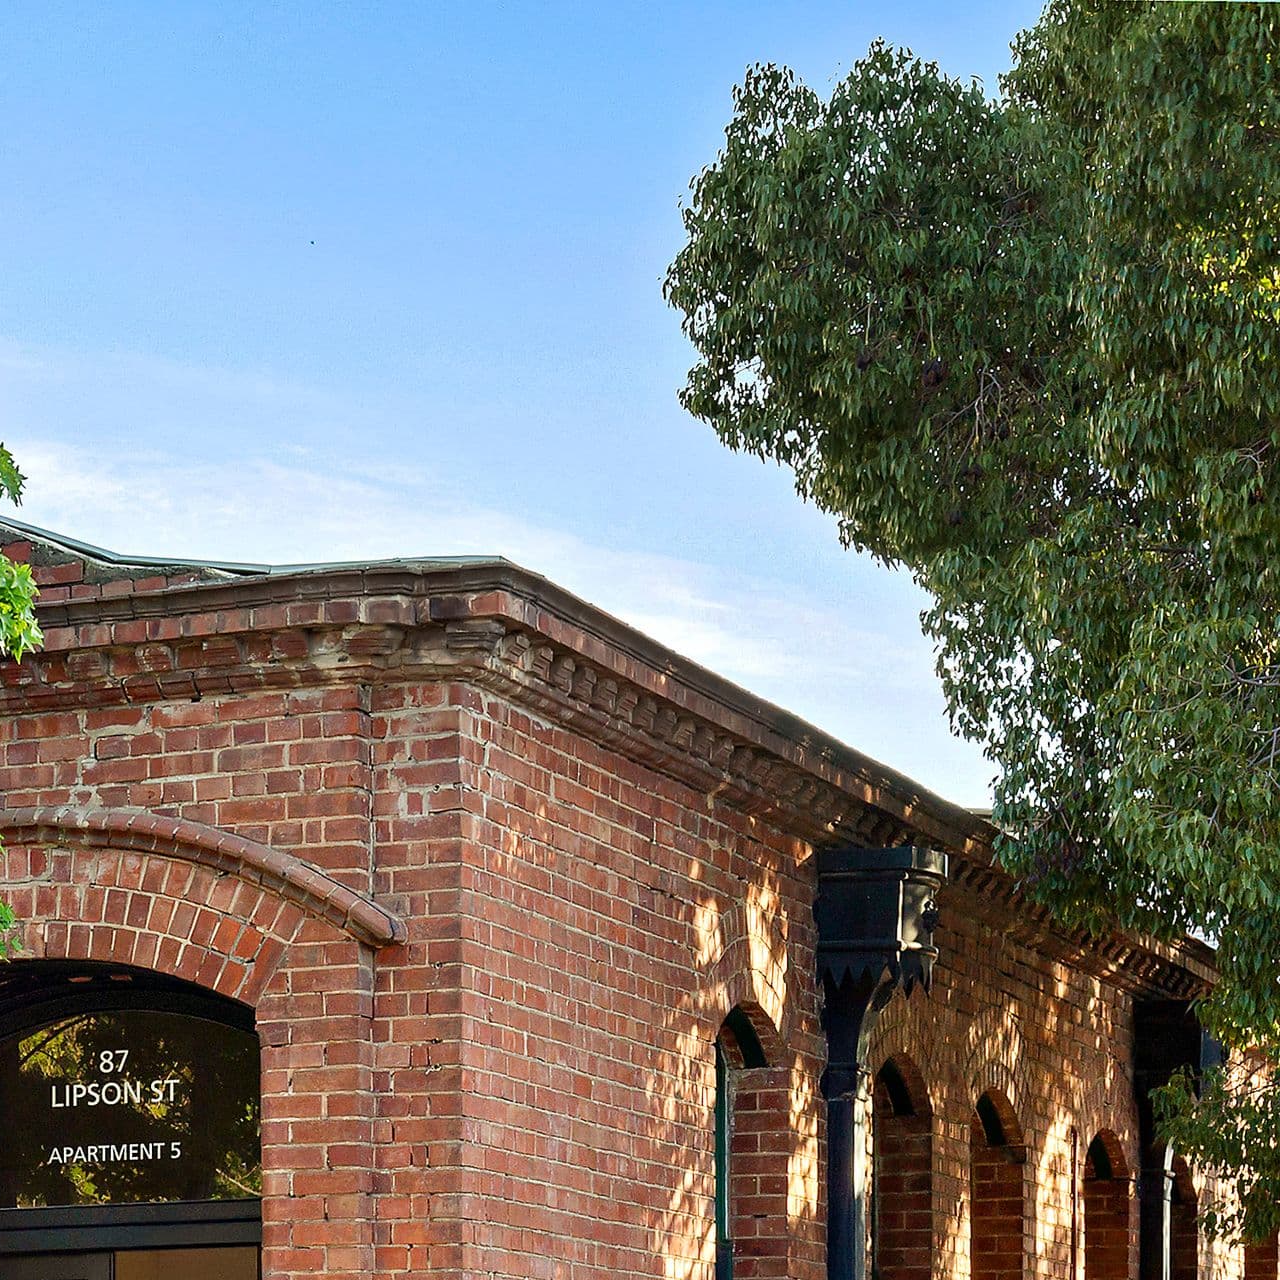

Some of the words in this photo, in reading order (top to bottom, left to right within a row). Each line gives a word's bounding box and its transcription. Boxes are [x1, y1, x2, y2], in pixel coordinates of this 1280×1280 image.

[99, 1050, 129, 1073] 87
[51, 1080, 141, 1108] LIPSON
[150, 1079, 180, 1103] ST
[47, 1142, 165, 1165] APARTMENT
[170, 1142, 181, 1159] 5
